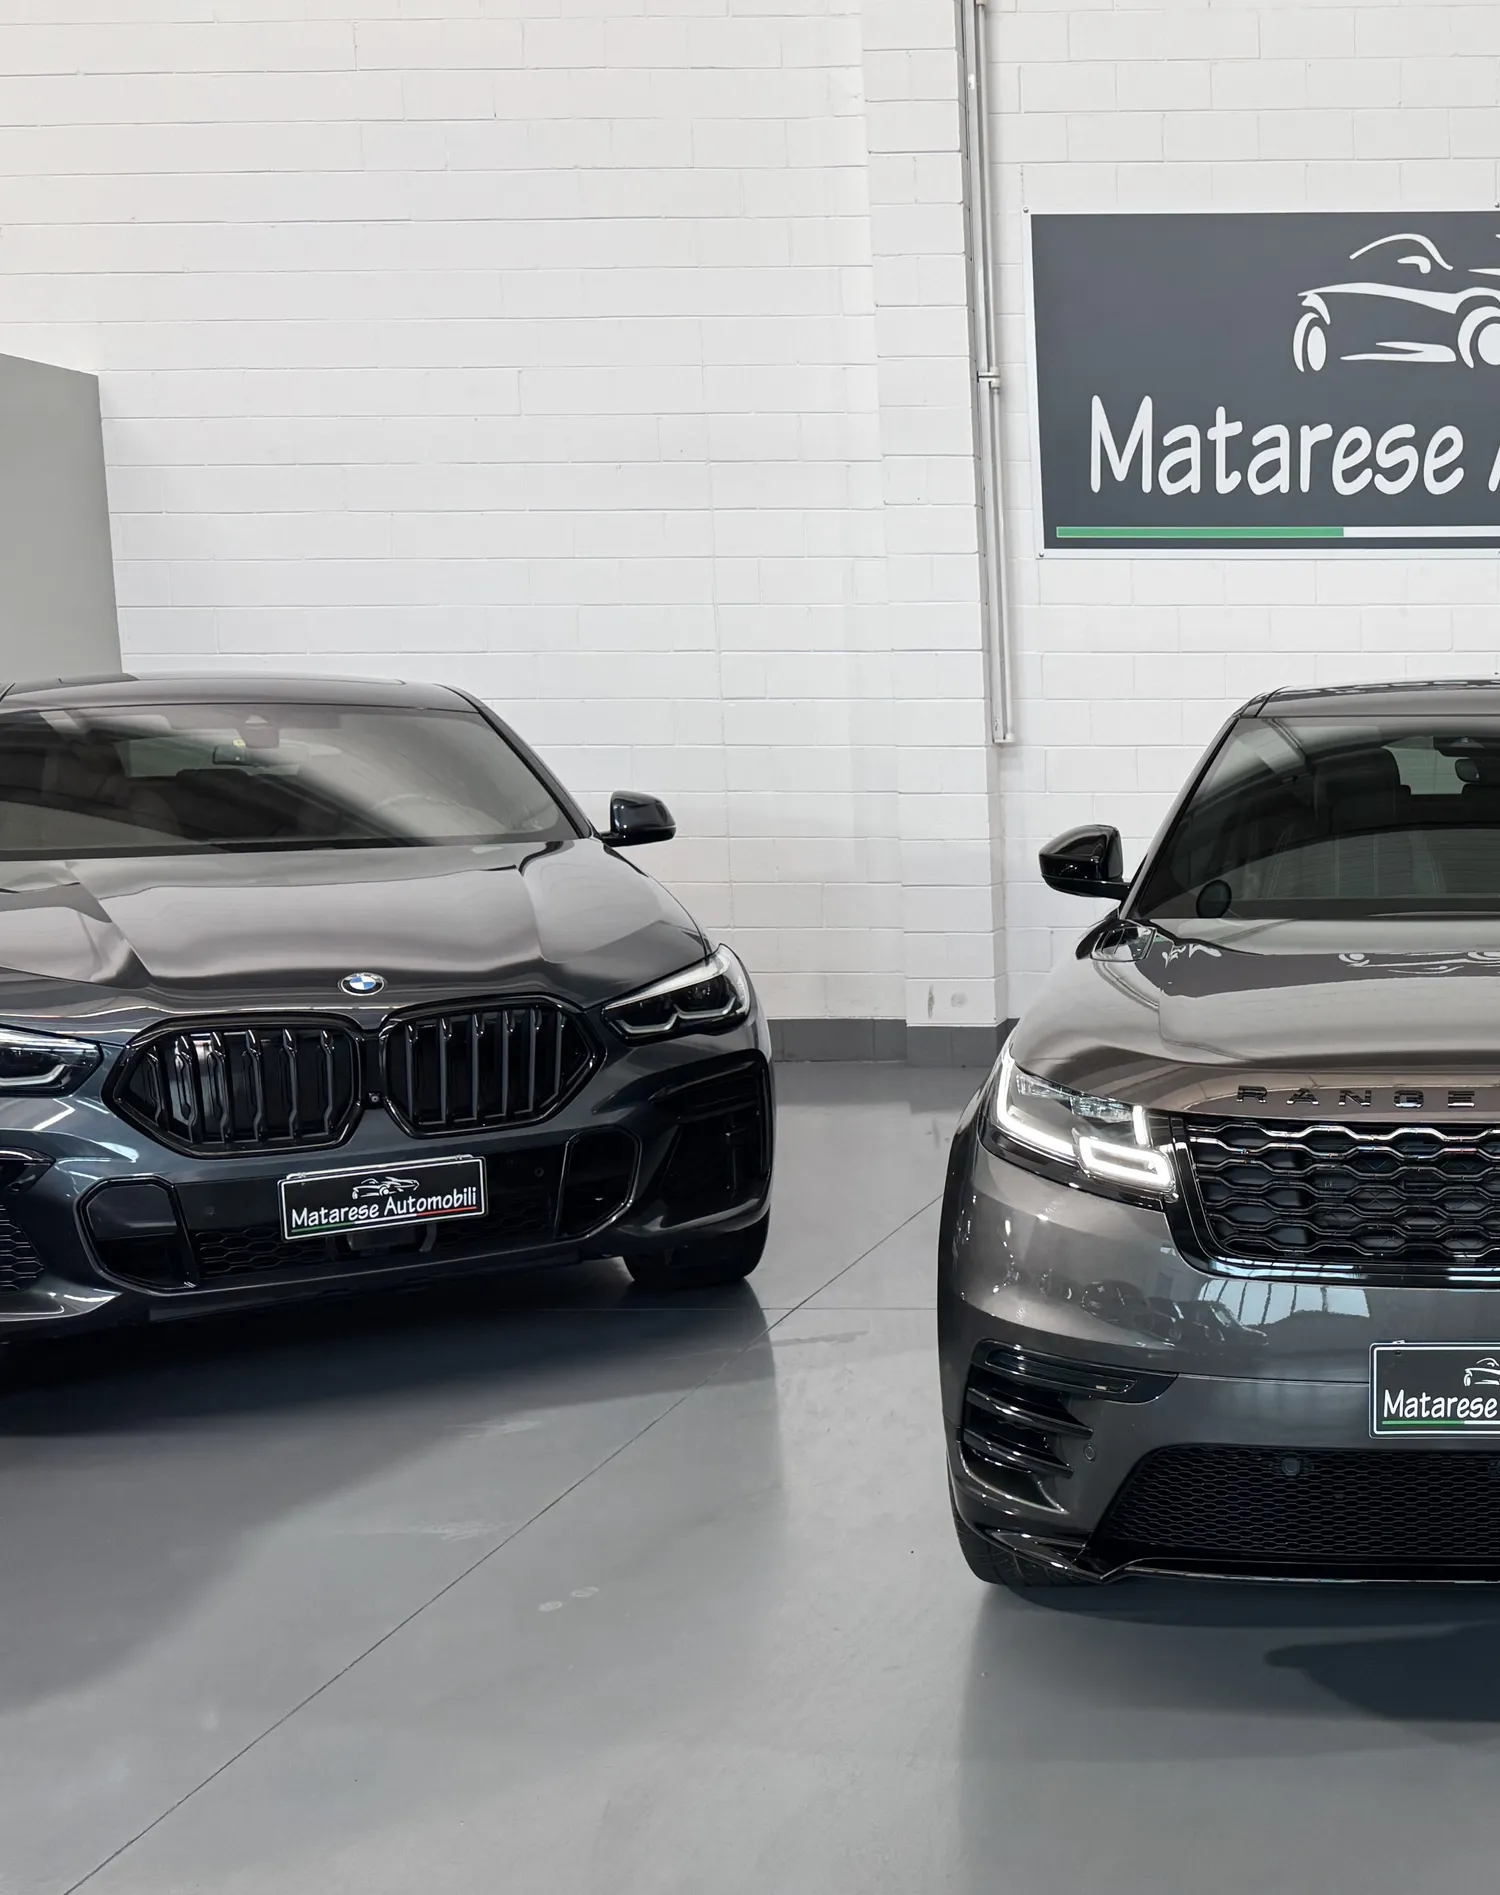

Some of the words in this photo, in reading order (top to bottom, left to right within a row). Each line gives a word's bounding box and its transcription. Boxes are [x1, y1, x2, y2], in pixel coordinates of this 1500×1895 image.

[1090, 395, 1464, 496] Matarese
[1236, 1084, 1476, 1108] RANGE
[291, 1204, 379, 1228] Matarese
[384, 1187, 477, 1216] Automobili
[1383, 1389, 1498, 1419] Matarese
